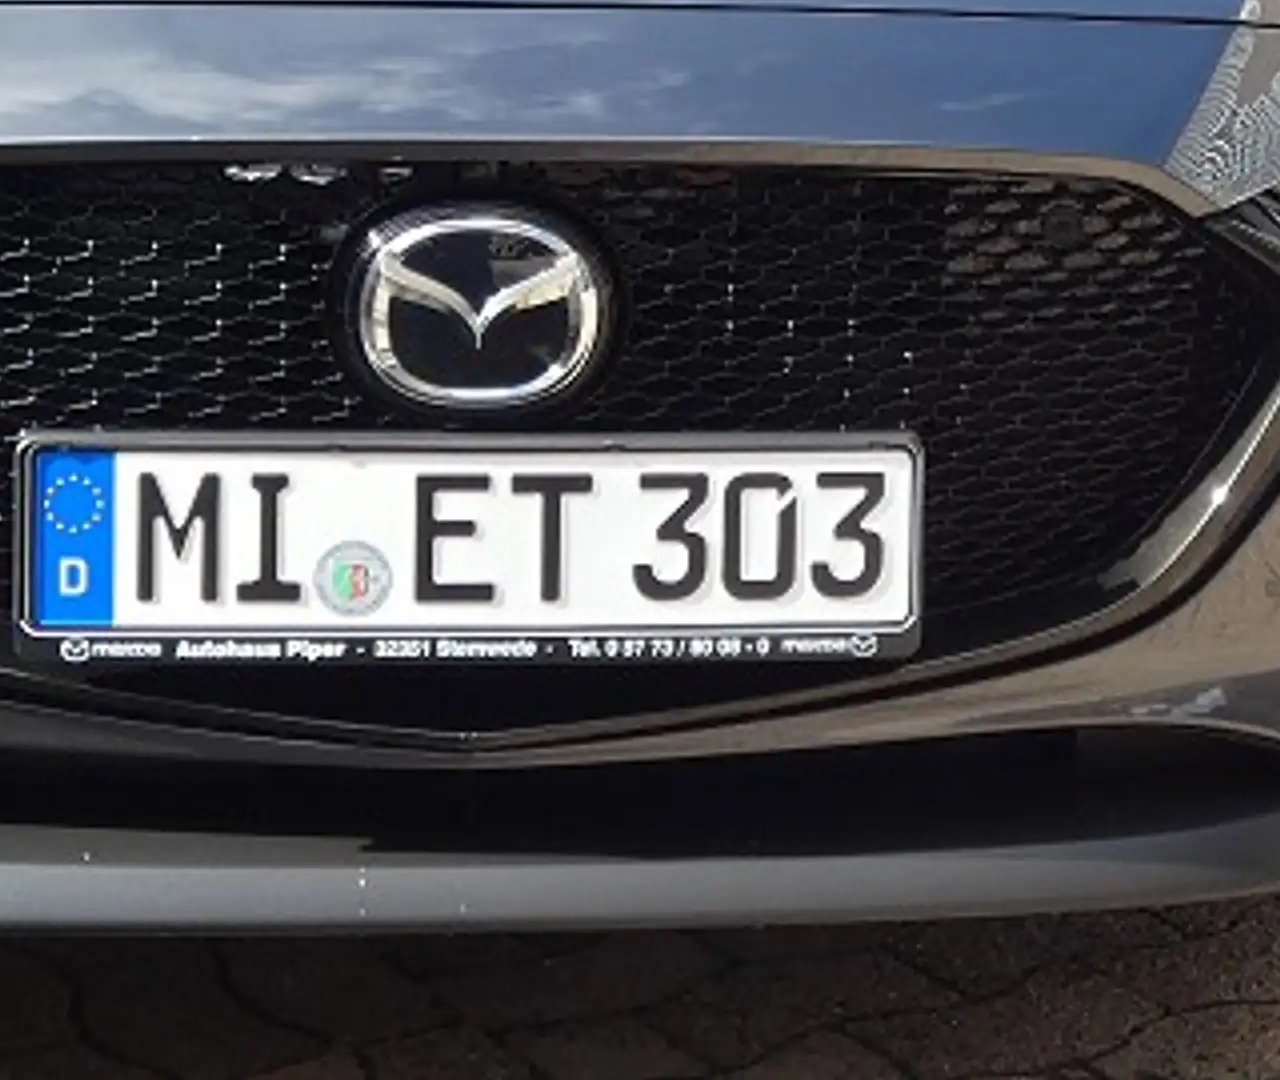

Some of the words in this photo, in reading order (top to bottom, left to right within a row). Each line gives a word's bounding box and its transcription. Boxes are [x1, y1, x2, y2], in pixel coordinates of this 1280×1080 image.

[138, 473, 301, 602] MI
[416, 475, 593, 602] ET
[633, 472, 885, 601] 303
[59, 556, 88, 596] D
[176, 639, 282, 658] Autohaus
[286, 639, 347, 661] Piper
